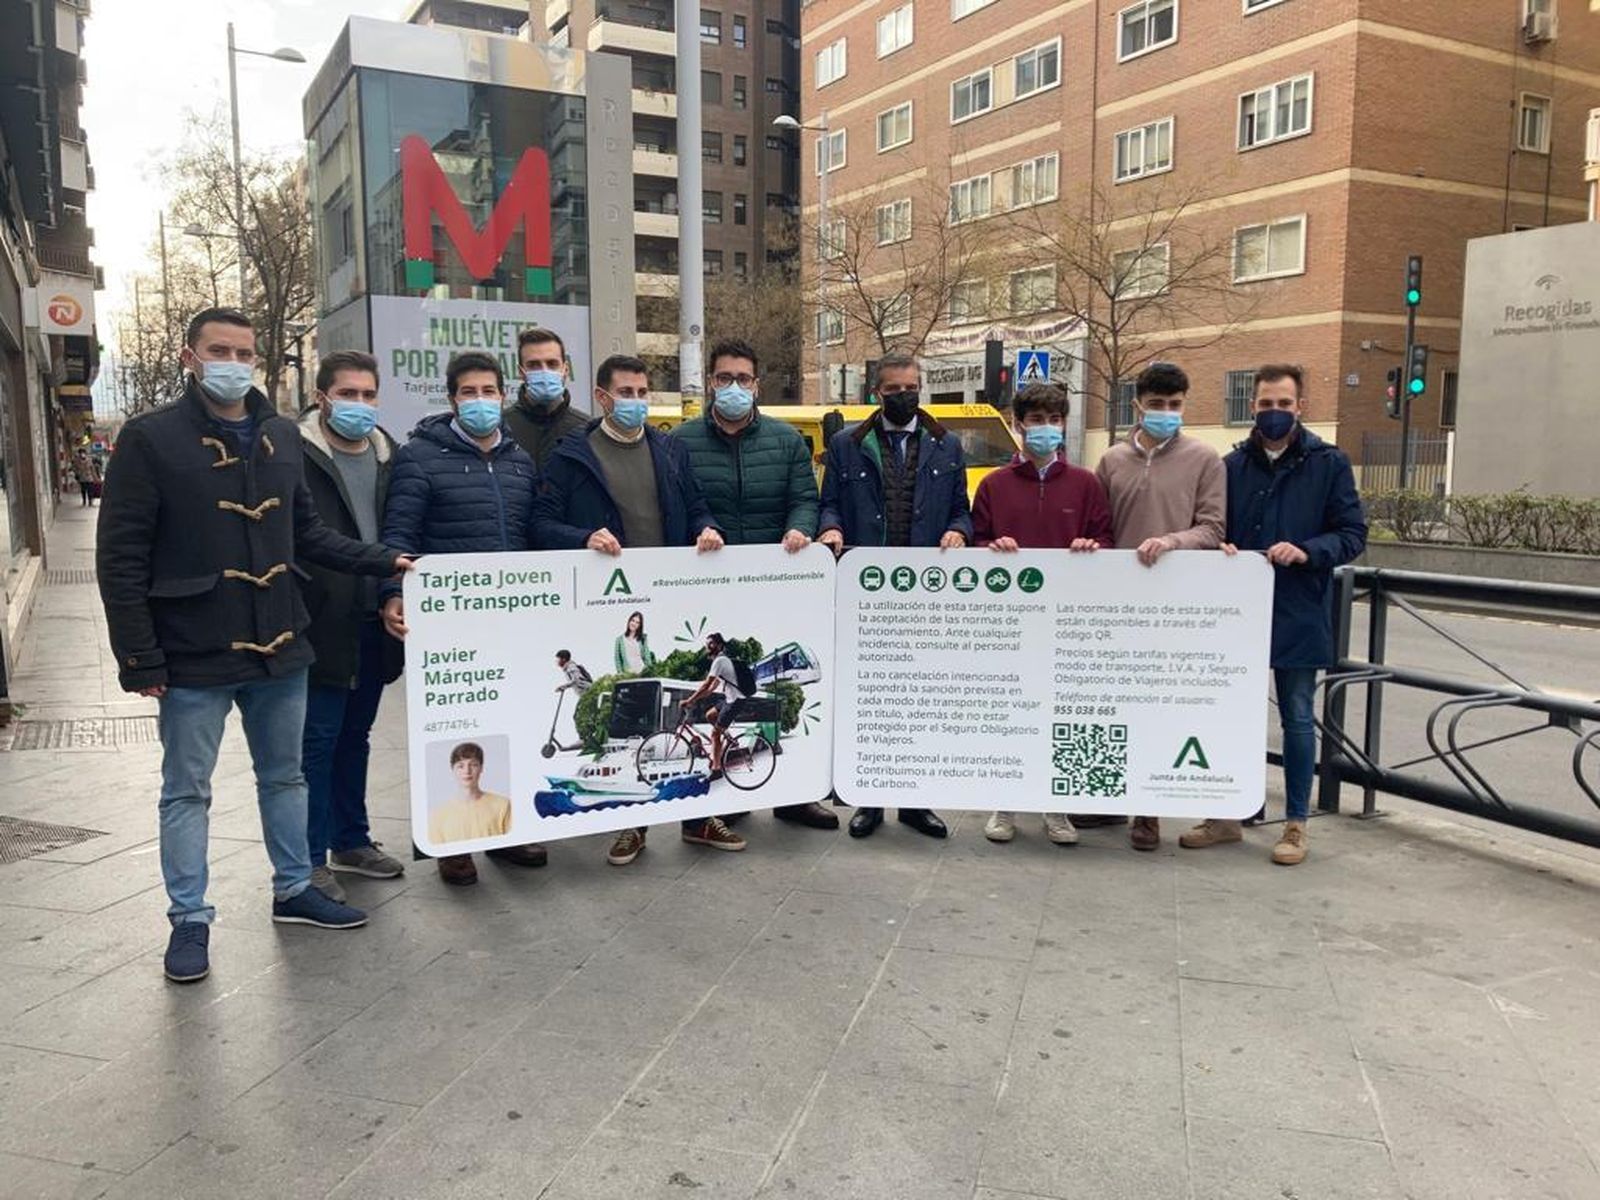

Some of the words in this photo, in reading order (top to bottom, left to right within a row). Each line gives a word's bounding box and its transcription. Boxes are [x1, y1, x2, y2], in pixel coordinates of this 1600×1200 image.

[1505, 299, 1592, 321] Recogidas
[392, 349, 439, 379] POR
[419, 571, 491, 591] Tarjeta
[497, 570, 552, 589] Joven
[421, 596, 445, 613] de
[452, 592, 561, 612] Transporte
[858, 601, 871, 610] La
[873, 601, 925, 611] utilización
[929, 602, 941, 611] de
[944, 602, 966, 611] esta
[968, 602, 1003, 614] tarjeta
[1006, 605, 1046, 614] supone
[1056, 604, 1074, 613] Las
[1077, 606, 1118, 614] normas
[1122, 605, 1135, 614] de
[1161, 605, 1175, 615] de
[1178, 605, 1200, 615] esta
[858, 613, 867, 623] la
[870, 614, 926, 625] aceptación
[929, 614, 941, 624] de
[944, 615, 960, 624] las
[1005, 615, 1019, 625] de
[1056, 616, 1085, 626] están
[1089, 617, 1150, 629] disponibles
[1163, 618, 1196, 628] través
[1199, 619, 1216, 628] del
[945, 628, 970, 637] Ante
[972, 628, 1022, 640] cualquier
[1055, 630, 1092, 641] código
[915, 641, 959, 650] consulte
[962, 641, 971, 651] al
[974, 642, 1020, 653] personal
[422, 648, 477, 668] Javier
[1055, 649, 1094, 659] Precios
[1096, 650, 1130, 661] según
[1132, 650, 1167, 660] tarifas
[1170, 651, 1216, 663] vigentes
[1219, 654, 1226, 663] y
[1054, 661, 1086, 671] modo
[1089, 662, 1103, 671] de
[1199, 666, 1205, 675] y
[1208, 664, 1248, 676] Seguro
[424, 667, 505, 687] Márquez
[857, 670, 870, 679] La
[888, 671, 948, 681] cancelación
[951, 672, 1020, 682] intencionada
[1054, 674, 1115, 686] Obligatorio
[1118, 675, 1132, 685] de
[1135, 676, 1178, 688] Viajeros
[857, 683, 907, 695] supondrá
[909, 684, 918, 693] la
[921, 684, 961, 694] sanción
[964, 685, 1005, 697] prevista
[425, 688, 499, 706] Parrado
[857, 696, 881, 705] cada
[884, 696, 915, 706] modo
[917, 697, 930, 706] de
[933, 697, 989, 709] transporte
[991, 700, 1009, 710] por
[1012, 699, 1041, 710] viajar
[1055, 693, 1097, 702] Teléfono
[1100, 693, 1113, 703] de
[1115, 694, 1159, 704] atención
[1162, 694, 1172, 704] al
[857, 709, 872, 718] sin
[907, 710, 948, 719] además
[950, 710, 963, 720] de
[983, 711, 1009, 720] estar
[1054, 705, 1073, 715] 955
[1075, 705, 1094, 715] 038
[1097, 706, 1116, 715] 665
[857, 722, 907, 734] protegido
[909, 725, 927, 734] por
[929, 724, 938, 733] el
[941, 724, 978, 735] Seguro
[981, 725, 1040, 737] Obligatorio
[857, 734, 870, 743] de
[857, 753, 892, 764] Tarjeta
[895, 753, 940, 765] personal
[856, 766, 926, 776] Contribuimos
[938, 768, 975, 777] reducir
[978, 768, 987, 778] la
[990, 769, 1024, 778] Huella
[856, 778, 869, 788] de
[1189, 775, 1234, 783] Andalucía
